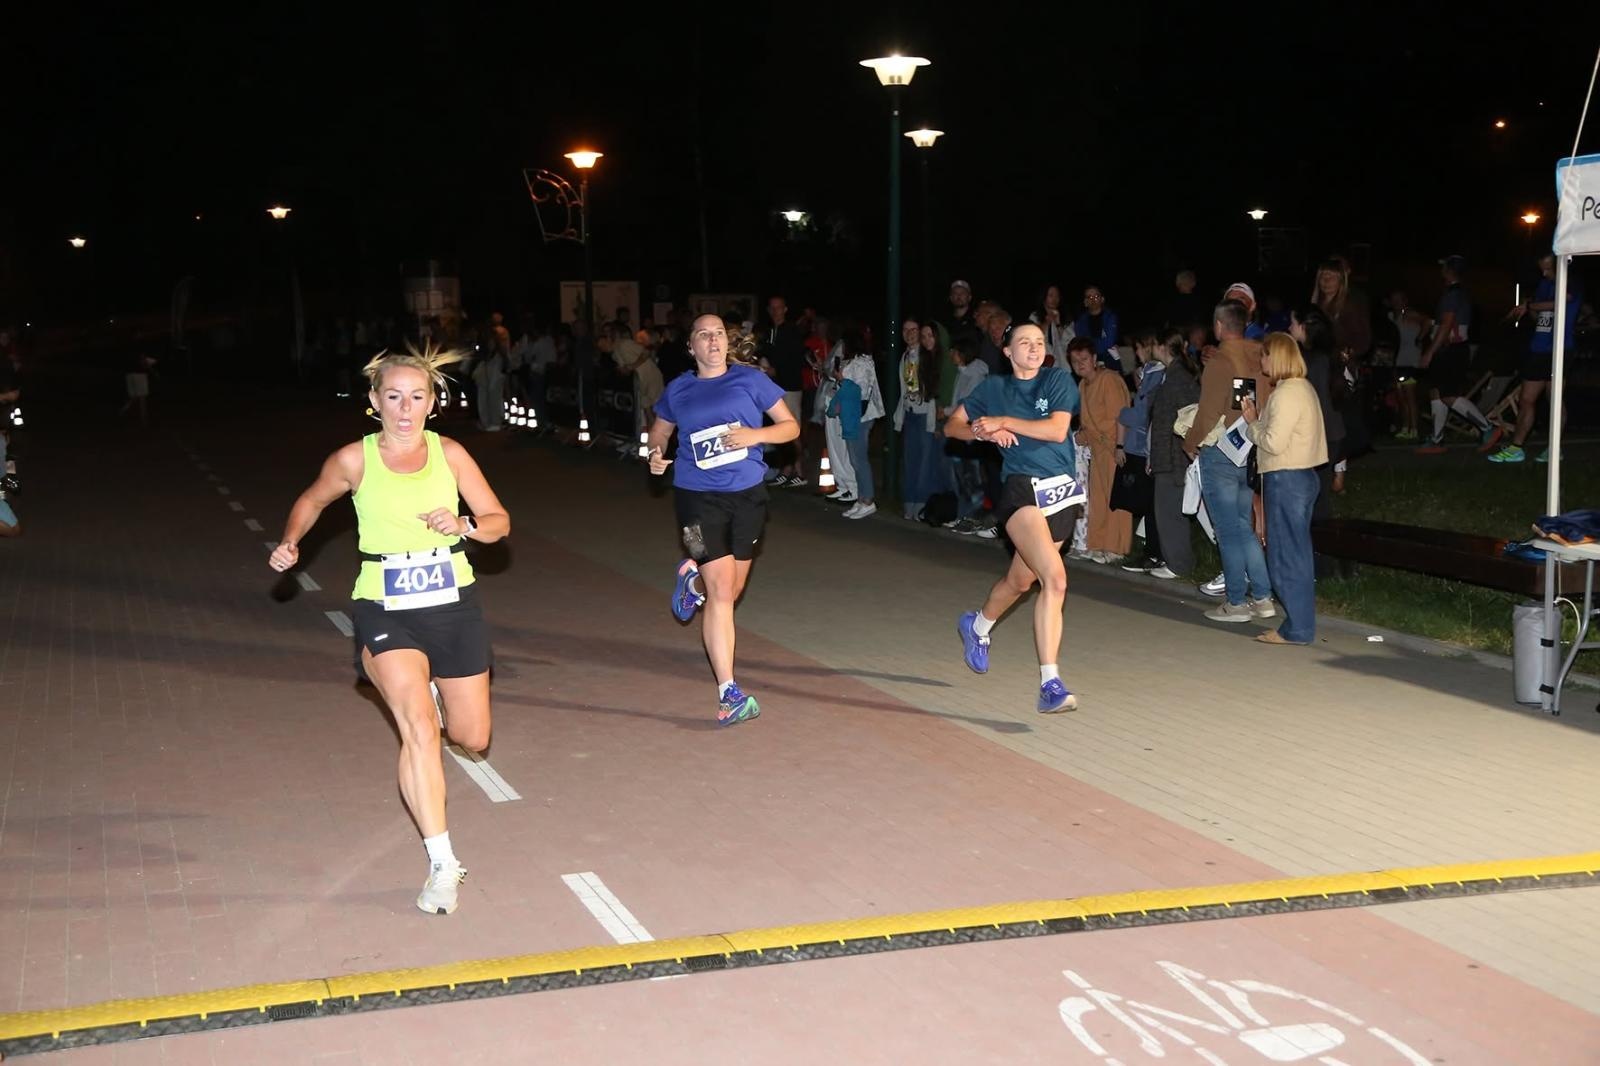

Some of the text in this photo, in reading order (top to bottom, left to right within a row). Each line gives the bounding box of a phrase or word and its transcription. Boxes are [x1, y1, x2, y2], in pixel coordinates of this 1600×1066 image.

[702, 437, 725, 458] 24
[1045, 481, 1076, 504] 397
[394, 565, 445, 592] 404
